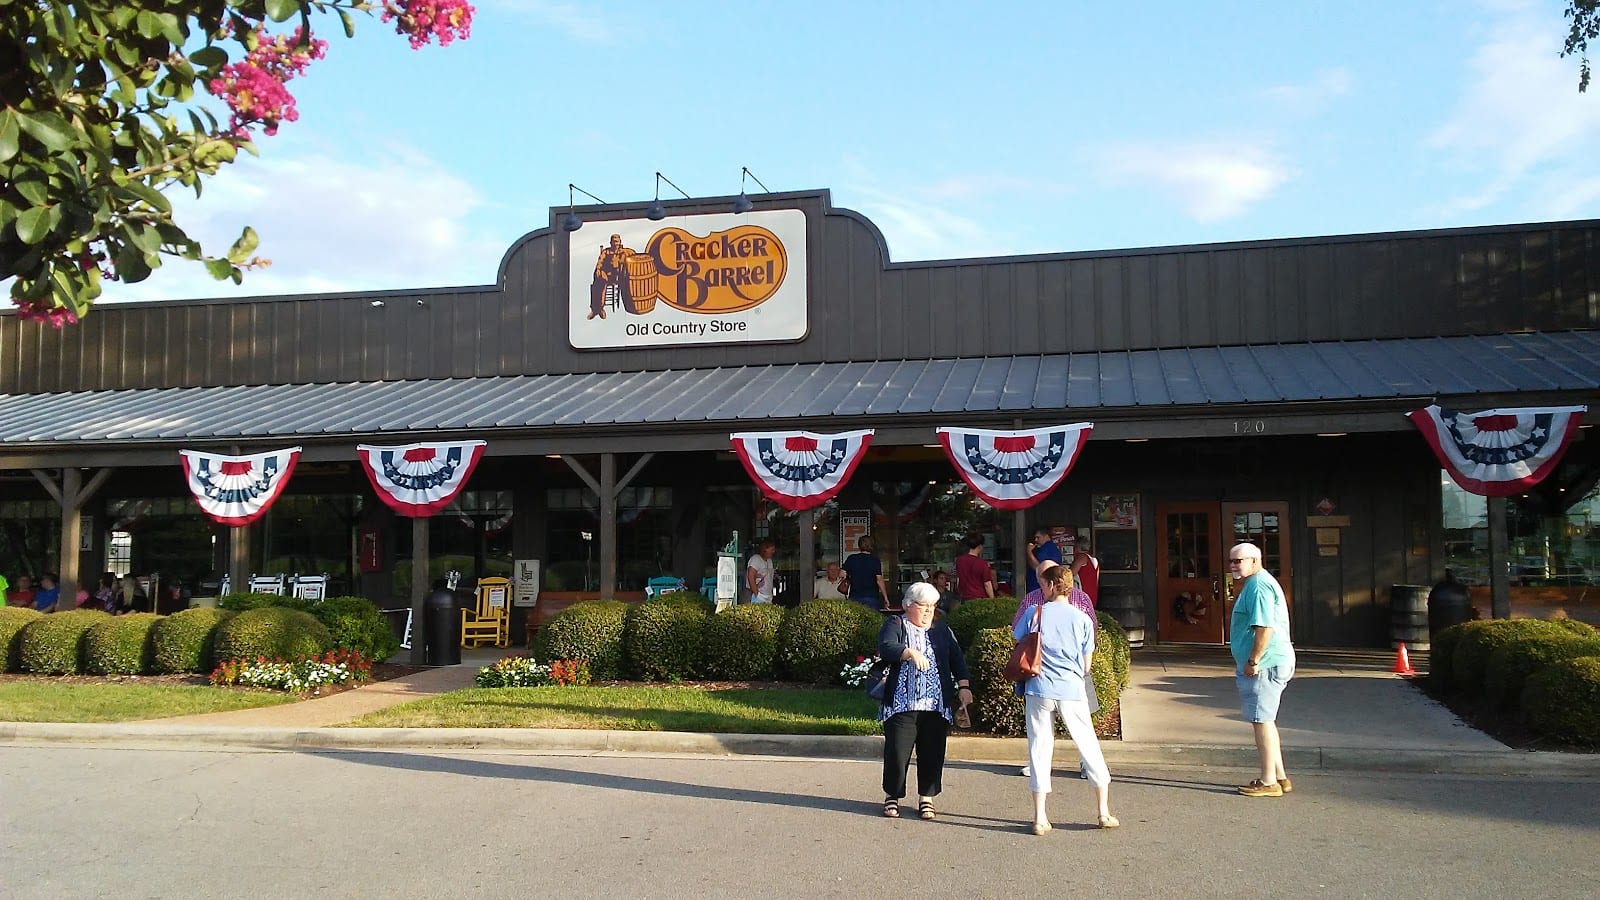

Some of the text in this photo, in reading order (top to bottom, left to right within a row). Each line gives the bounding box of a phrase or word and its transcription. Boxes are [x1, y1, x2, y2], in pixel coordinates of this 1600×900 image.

[649, 232, 769, 276] Cracker
[676, 260, 774, 308] Barrel
[626, 319, 747, 336] Old Country Store
[1233, 420, 1265, 433] 120
